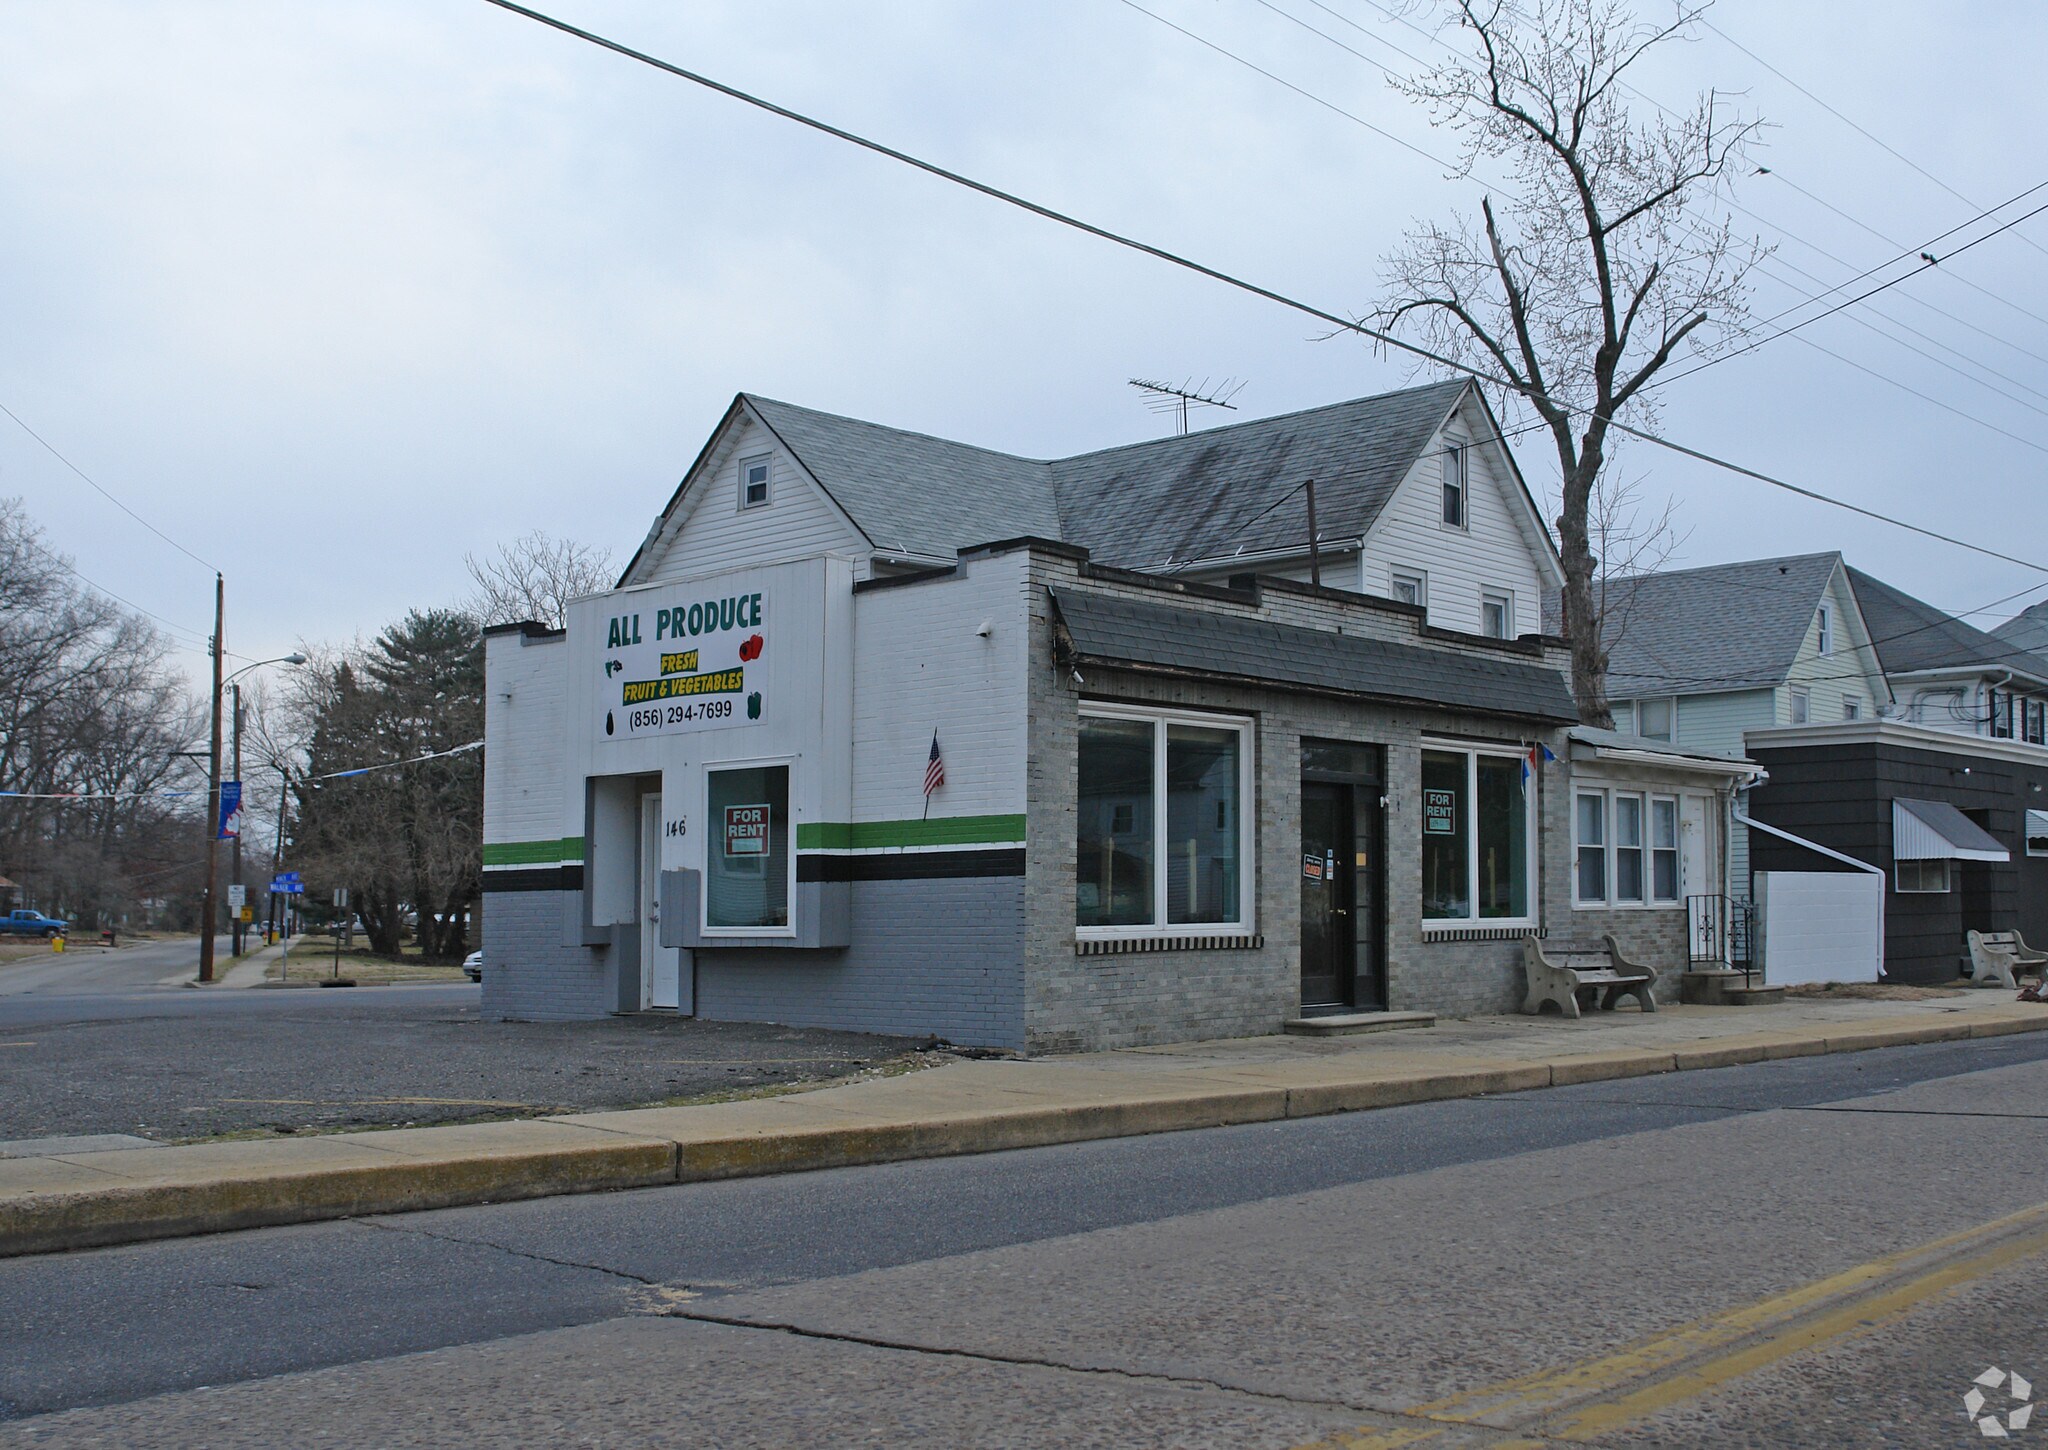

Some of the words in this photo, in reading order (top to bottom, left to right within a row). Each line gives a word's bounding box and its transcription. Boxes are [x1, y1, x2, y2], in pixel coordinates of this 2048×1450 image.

[607, 614, 642, 649] ALL
[656, 593, 762, 641] PRODUCE
[661, 652, 698, 673] FRESH
[623, 681, 657, 702] FRUIT
[659, 683, 668, 697] &
[671, 671, 743, 695] VEGETABLES
[629, 708, 663, 732] (856)
[667, 700, 732, 724] 294-7699
[1430, 794, 1449, 805] FOR
[732, 810, 761, 822] FOR
[1427, 806, 1452, 817] RENT
[666, 820, 686, 837] 146
[728, 824, 767, 837] RENT
